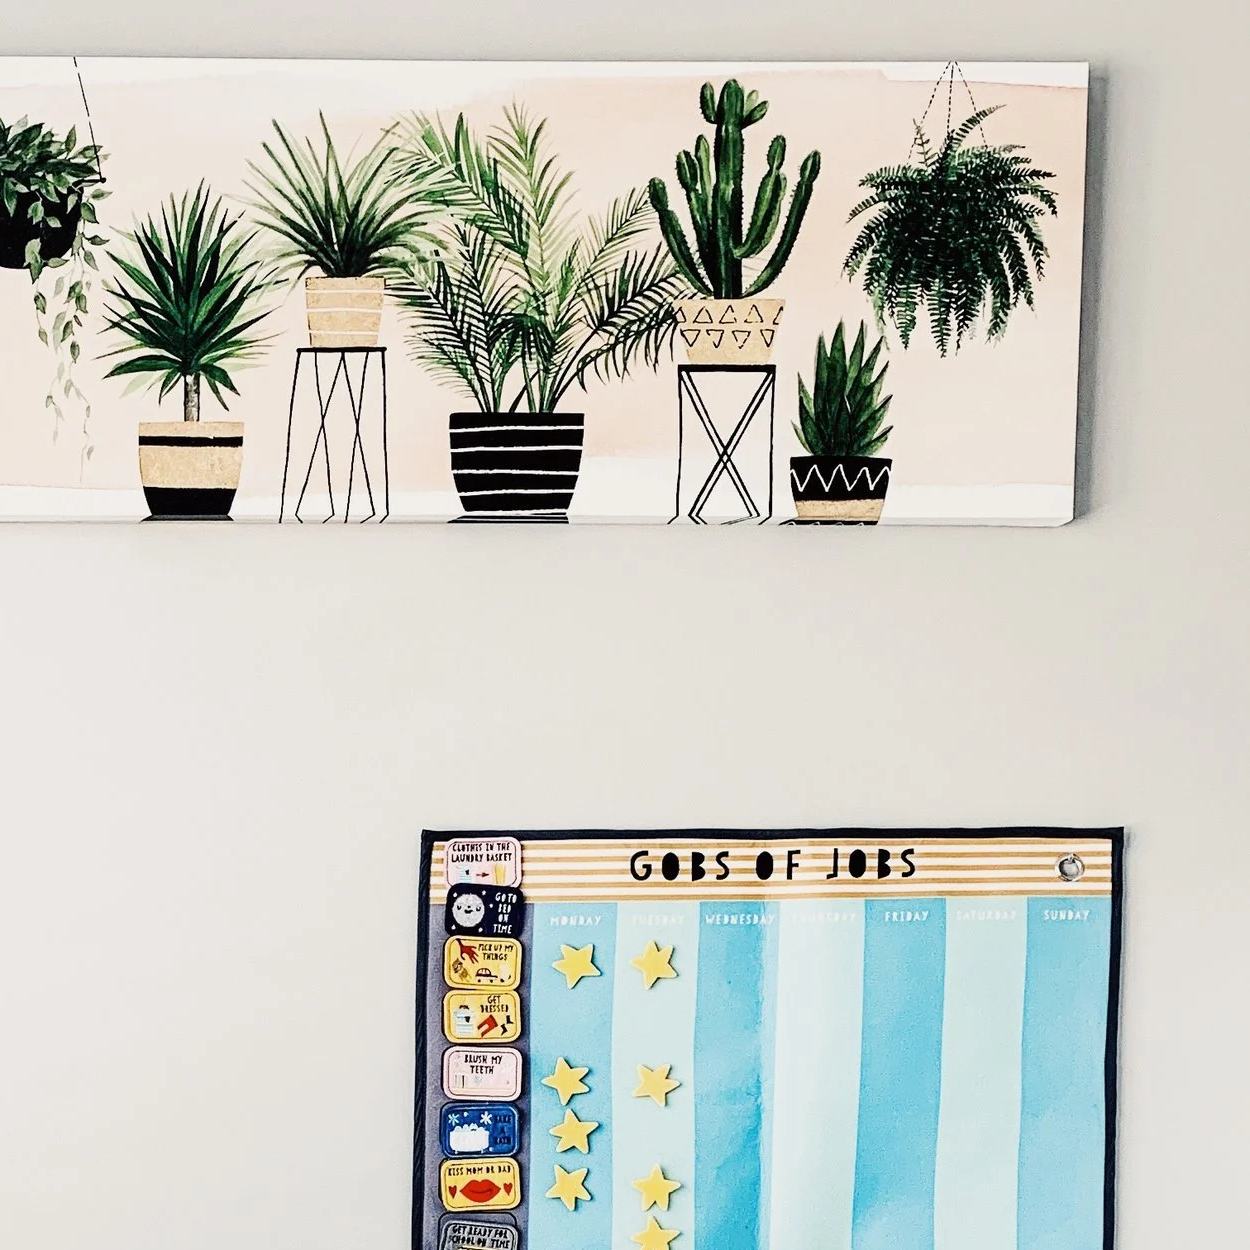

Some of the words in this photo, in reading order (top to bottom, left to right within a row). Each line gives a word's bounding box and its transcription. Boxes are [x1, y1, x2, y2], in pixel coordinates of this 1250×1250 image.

[452, 843, 483, 852] CLOTHES
[486, 843, 495, 852] IN
[497, 842, 510, 851] THE
[451, 853, 483, 863] LAUNDRY
[486, 853, 512, 862] BASKET
[630, 850, 730, 881] GOBS
[756, 849, 802, 881] OF
[826, 847, 917, 880] JOBS
[495, 892, 506, 903] GO
[507, 893, 517, 904] TO
[498, 903, 511, 914] BED
[498, 914, 509, 923] ON
[549, 914, 602, 926] MONDAY
[631, 914, 684, 926] TUESDAY
[705, 913, 776, 925] WEDNESDAY
[791, 912, 856, 924] THURSDAY
[884, 911, 930, 922] FRIDAY
[956, 910, 1017, 921] SATURDAY
[1043, 909, 1091, 921] SUNDAY
[493, 923, 512, 934] TIME
[494, 944, 502, 952] UP
[504, 945, 514, 953] MY
[482, 952, 508, 961] THINGS
[487, 995, 501, 1004] GET
[480, 1004, 509, 1014] DRESSED
[464, 1054, 487, 1064] BRUSH
[491, 1055, 502, 1064] MY
[470, 1065, 494, 1074] TEETH
[448, 1167, 464, 1176] KISS
[466, 1166, 483, 1175] MOM
[486, 1165, 495, 1174] OR
[498, 1165, 511, 1174] DAD
[452, 1225, 467, 1234] GET
[469, 1226, 492, 1237] READY
[494, 1228, 508, 1239] FOR
[449, 1235, 475, 1245] SCHOOL
[477, 1236, 486, 1247] ON
[491, 1238, 510, 1249] TIME
